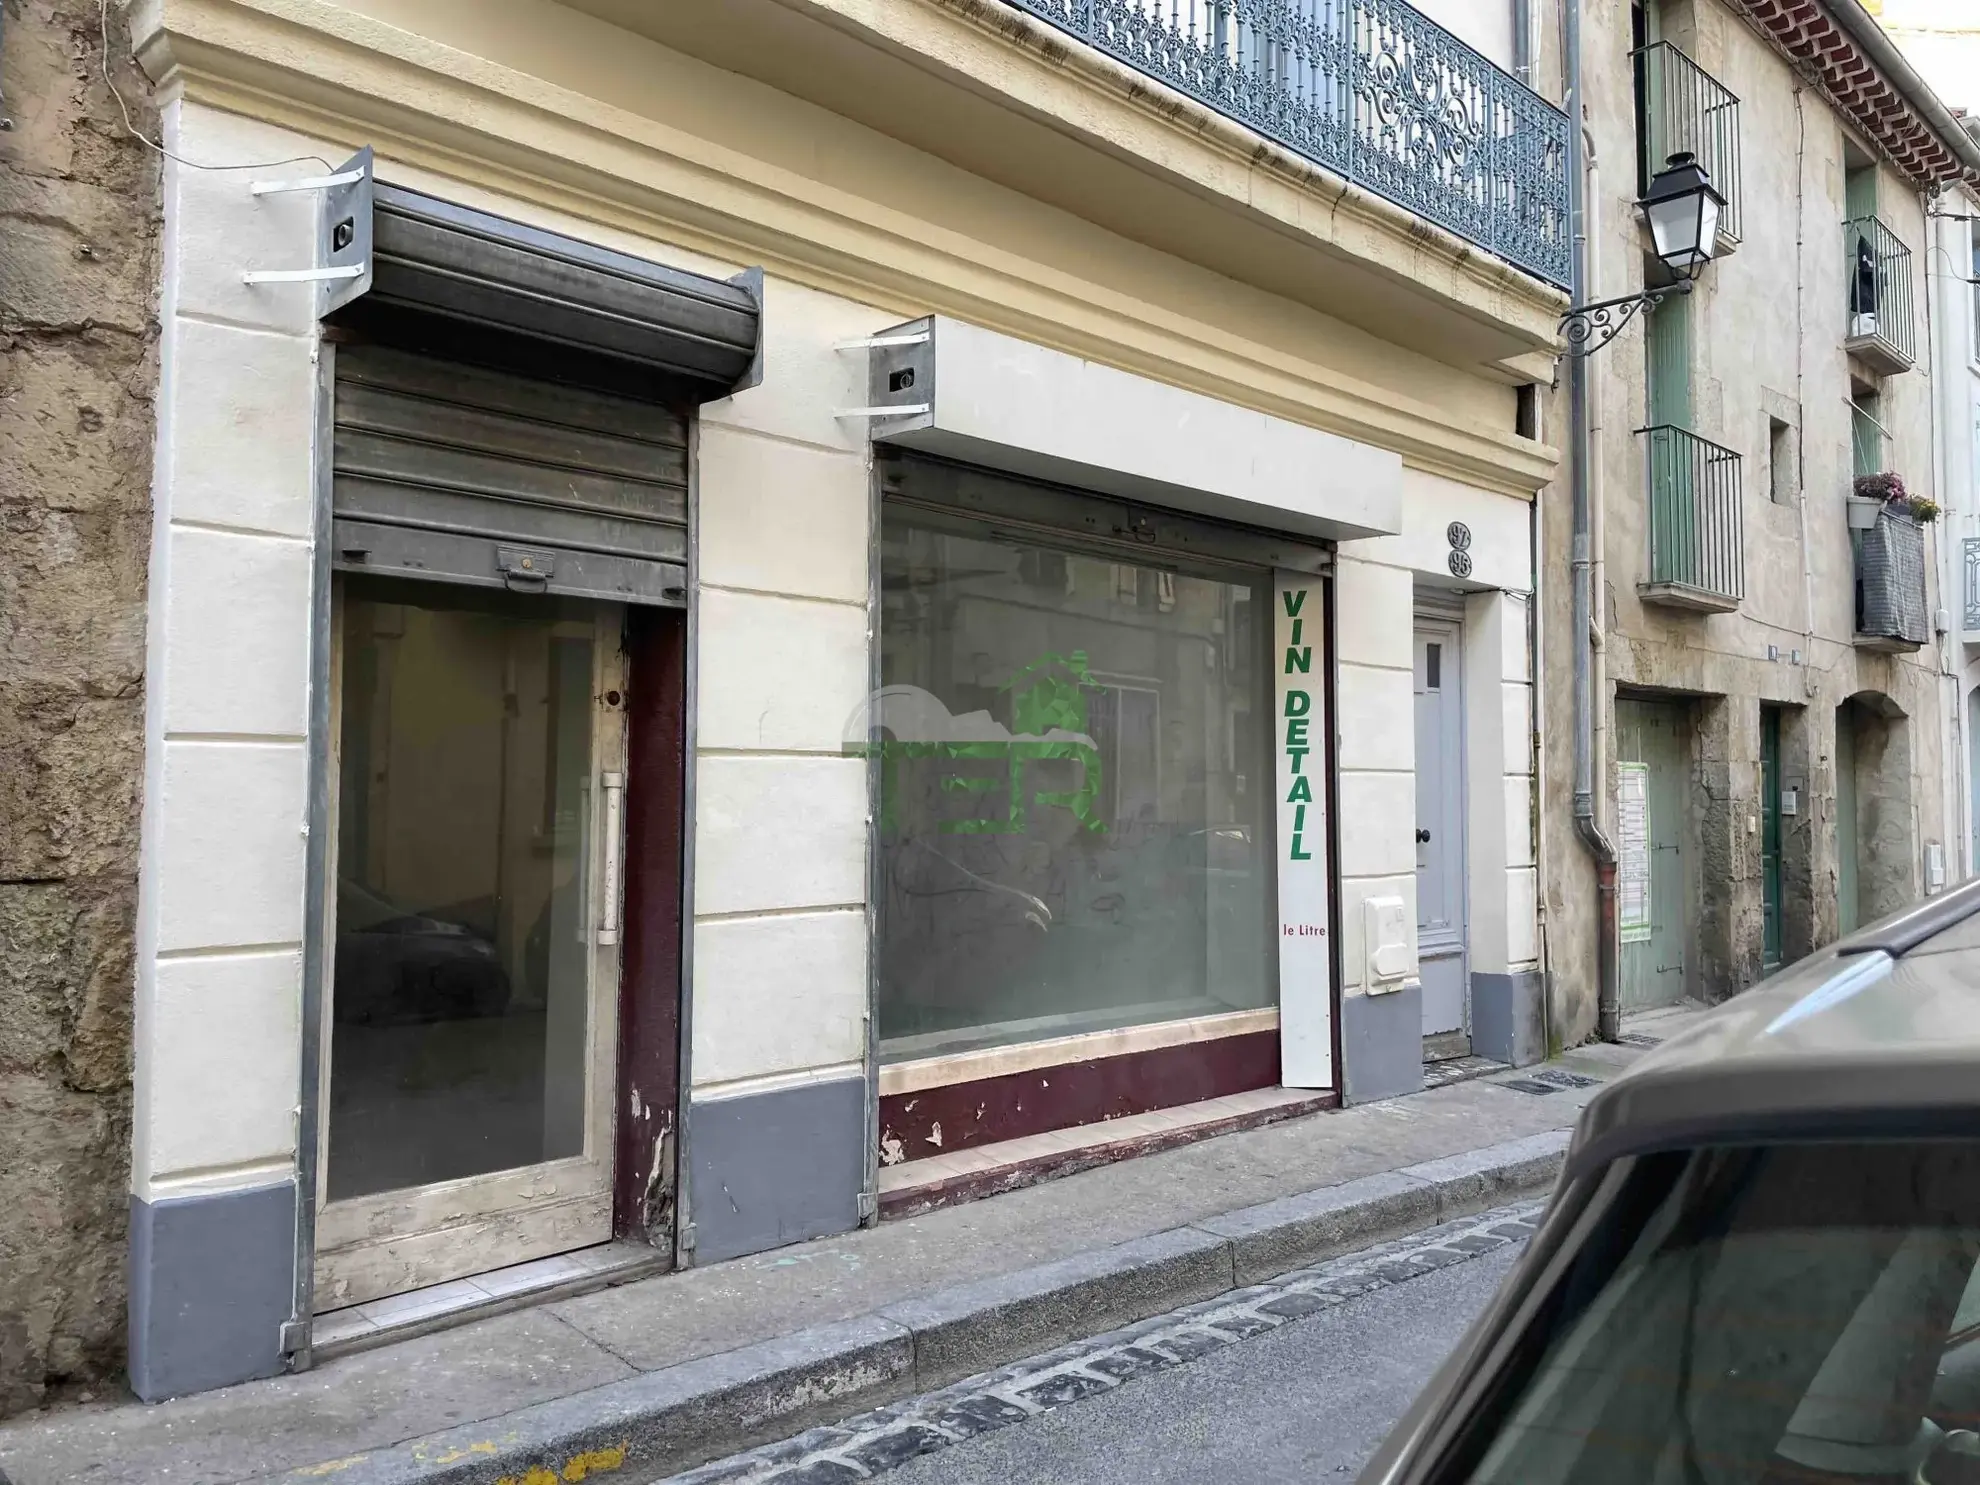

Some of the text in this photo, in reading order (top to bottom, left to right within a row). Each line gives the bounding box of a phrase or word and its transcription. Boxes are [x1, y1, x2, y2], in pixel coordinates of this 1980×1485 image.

[1283, 590, 1313, 860] VIN DETAIL
[1283, 923, 1326, 936] le Litre
